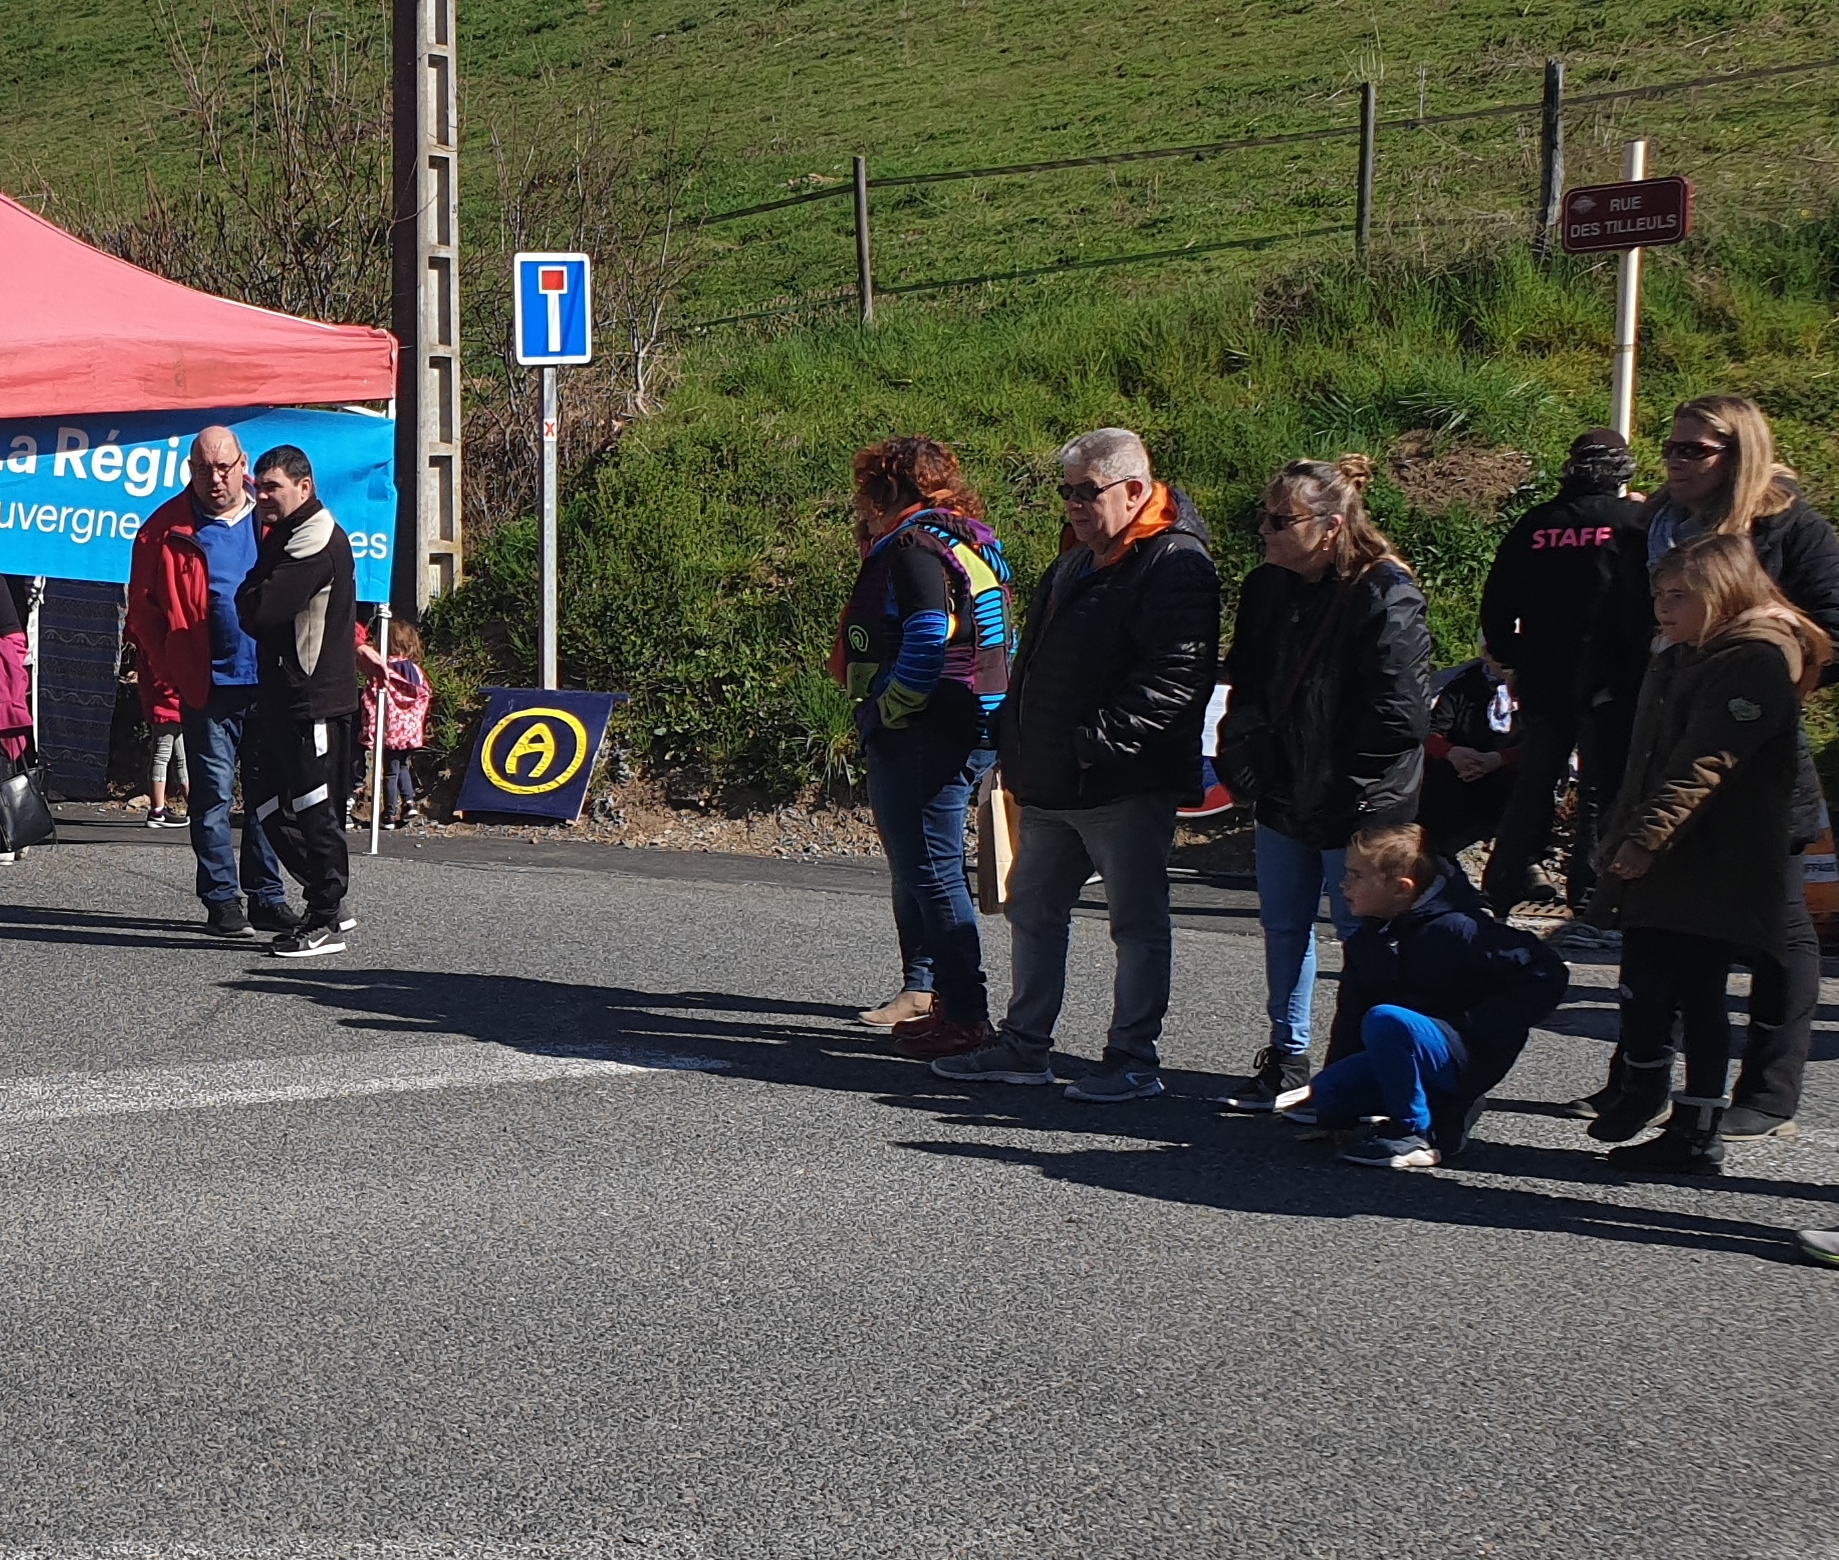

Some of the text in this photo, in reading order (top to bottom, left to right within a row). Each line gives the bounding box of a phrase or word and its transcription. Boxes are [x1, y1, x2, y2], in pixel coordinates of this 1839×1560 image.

[1609, 196, 1643, 212] RUE
[1570, 214, 1677, 238] DES TILLEULS
[1531, 526, 1613, 549] STAFF
[505, 722, 556, 778] A
